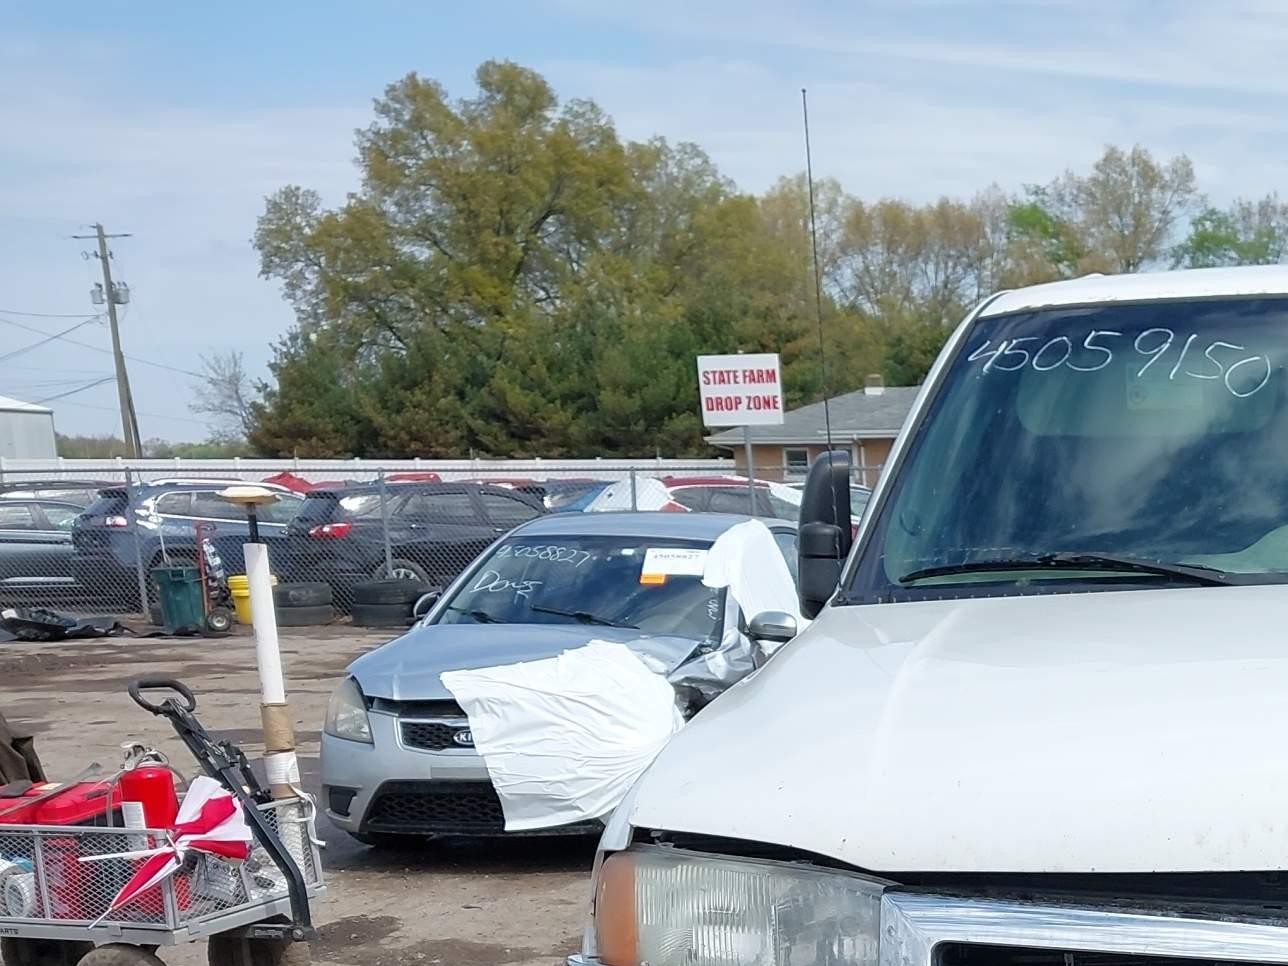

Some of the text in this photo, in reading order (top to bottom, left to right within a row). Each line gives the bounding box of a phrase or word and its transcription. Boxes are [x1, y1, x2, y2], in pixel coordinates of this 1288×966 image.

[967, 328, 1271, 397] 45059150
[702, 369, 776, 385] STATE FARM
[705, 395, 779, 411] DROP ZONE
